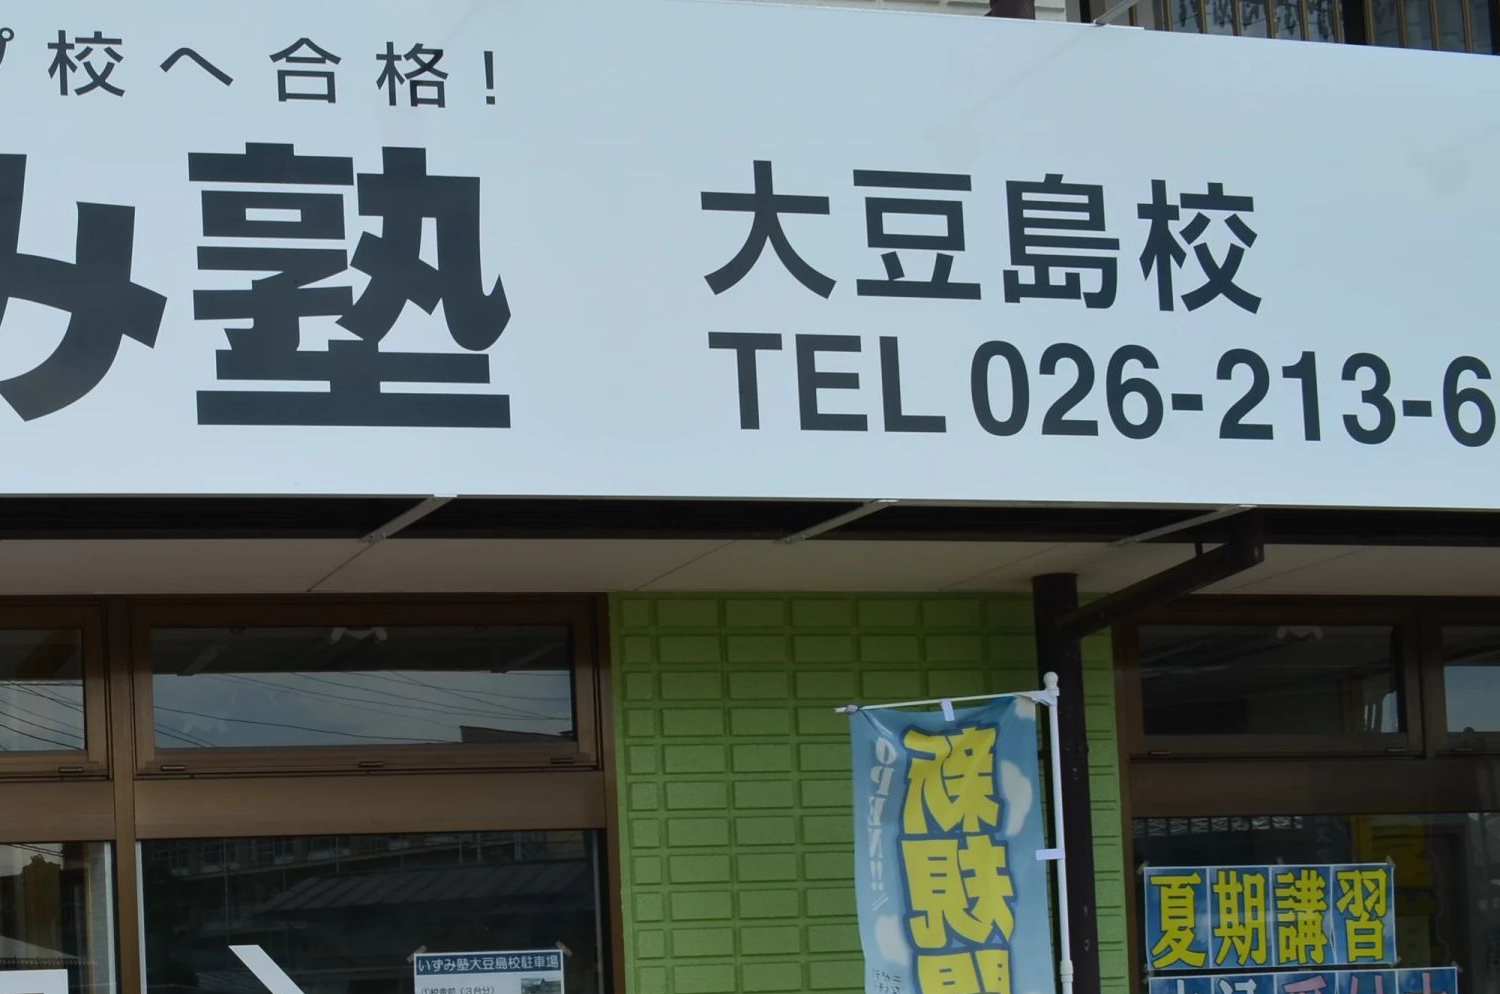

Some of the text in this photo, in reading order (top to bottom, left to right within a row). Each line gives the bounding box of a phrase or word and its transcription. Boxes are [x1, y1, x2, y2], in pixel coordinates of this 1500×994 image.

[701, 160, 1262, 315] 大豆島校
[418, 955, 559, 973] いずみ塾大豆島校駐車場
[1150, 867, 1388, 969] 夏期講習
